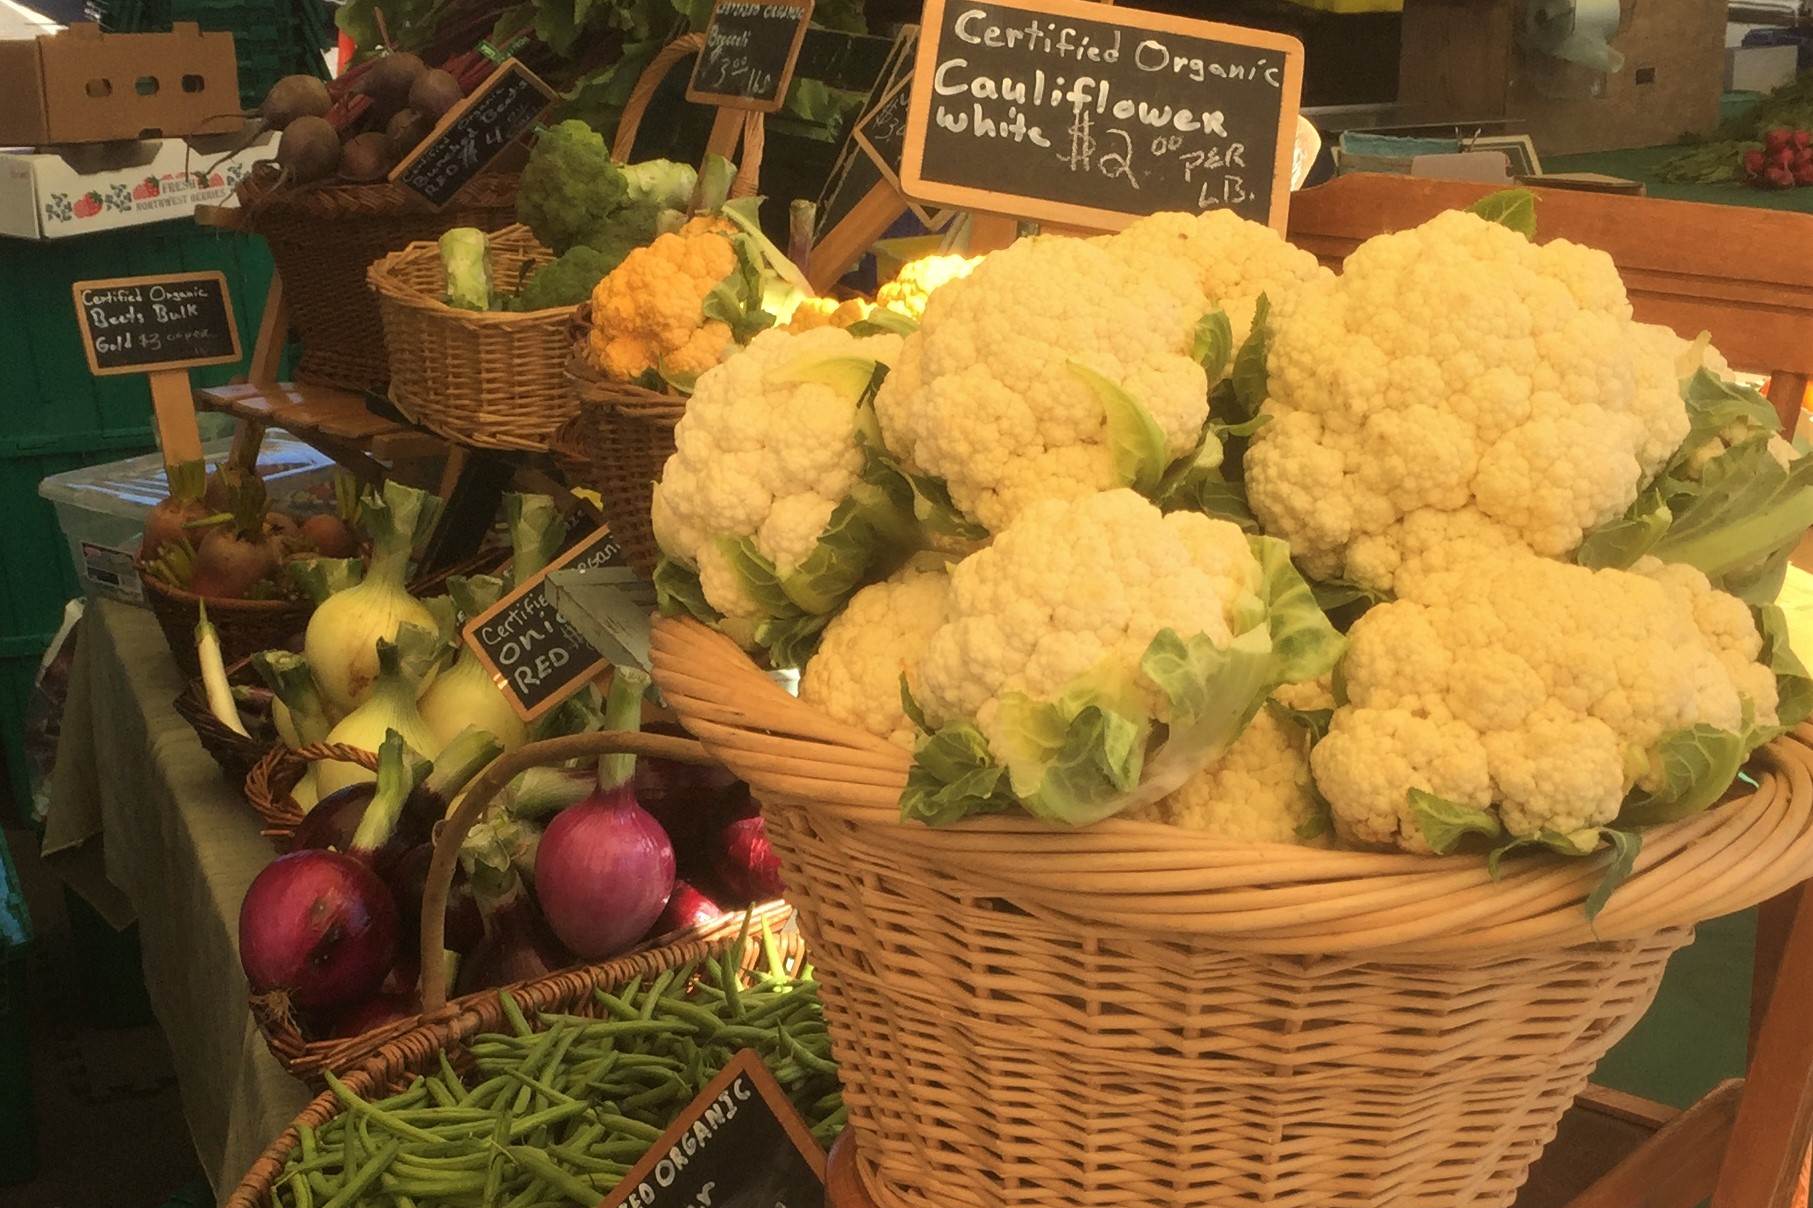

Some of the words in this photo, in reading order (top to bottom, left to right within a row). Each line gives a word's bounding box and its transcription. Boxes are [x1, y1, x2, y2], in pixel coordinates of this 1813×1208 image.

[954, 9, 1121, 64] Certified
[1134, 39, 1281, 87] Organic
[935, 102, 1052, 148] white
[1178, 143, 1246, 183] PER
[82, 288, 143, 306] Certified
[150, 285, 209, 302] Organic
[90, 305, 145, 328] Beets
[152, 303, 199, 323] Bulk
[95, 332, 132, 353] Gold
[482, 592, 549, 646] Certifie
[514, 647, 570, 694] RED
[654, 1077, 751, 1188] ORGANIC
